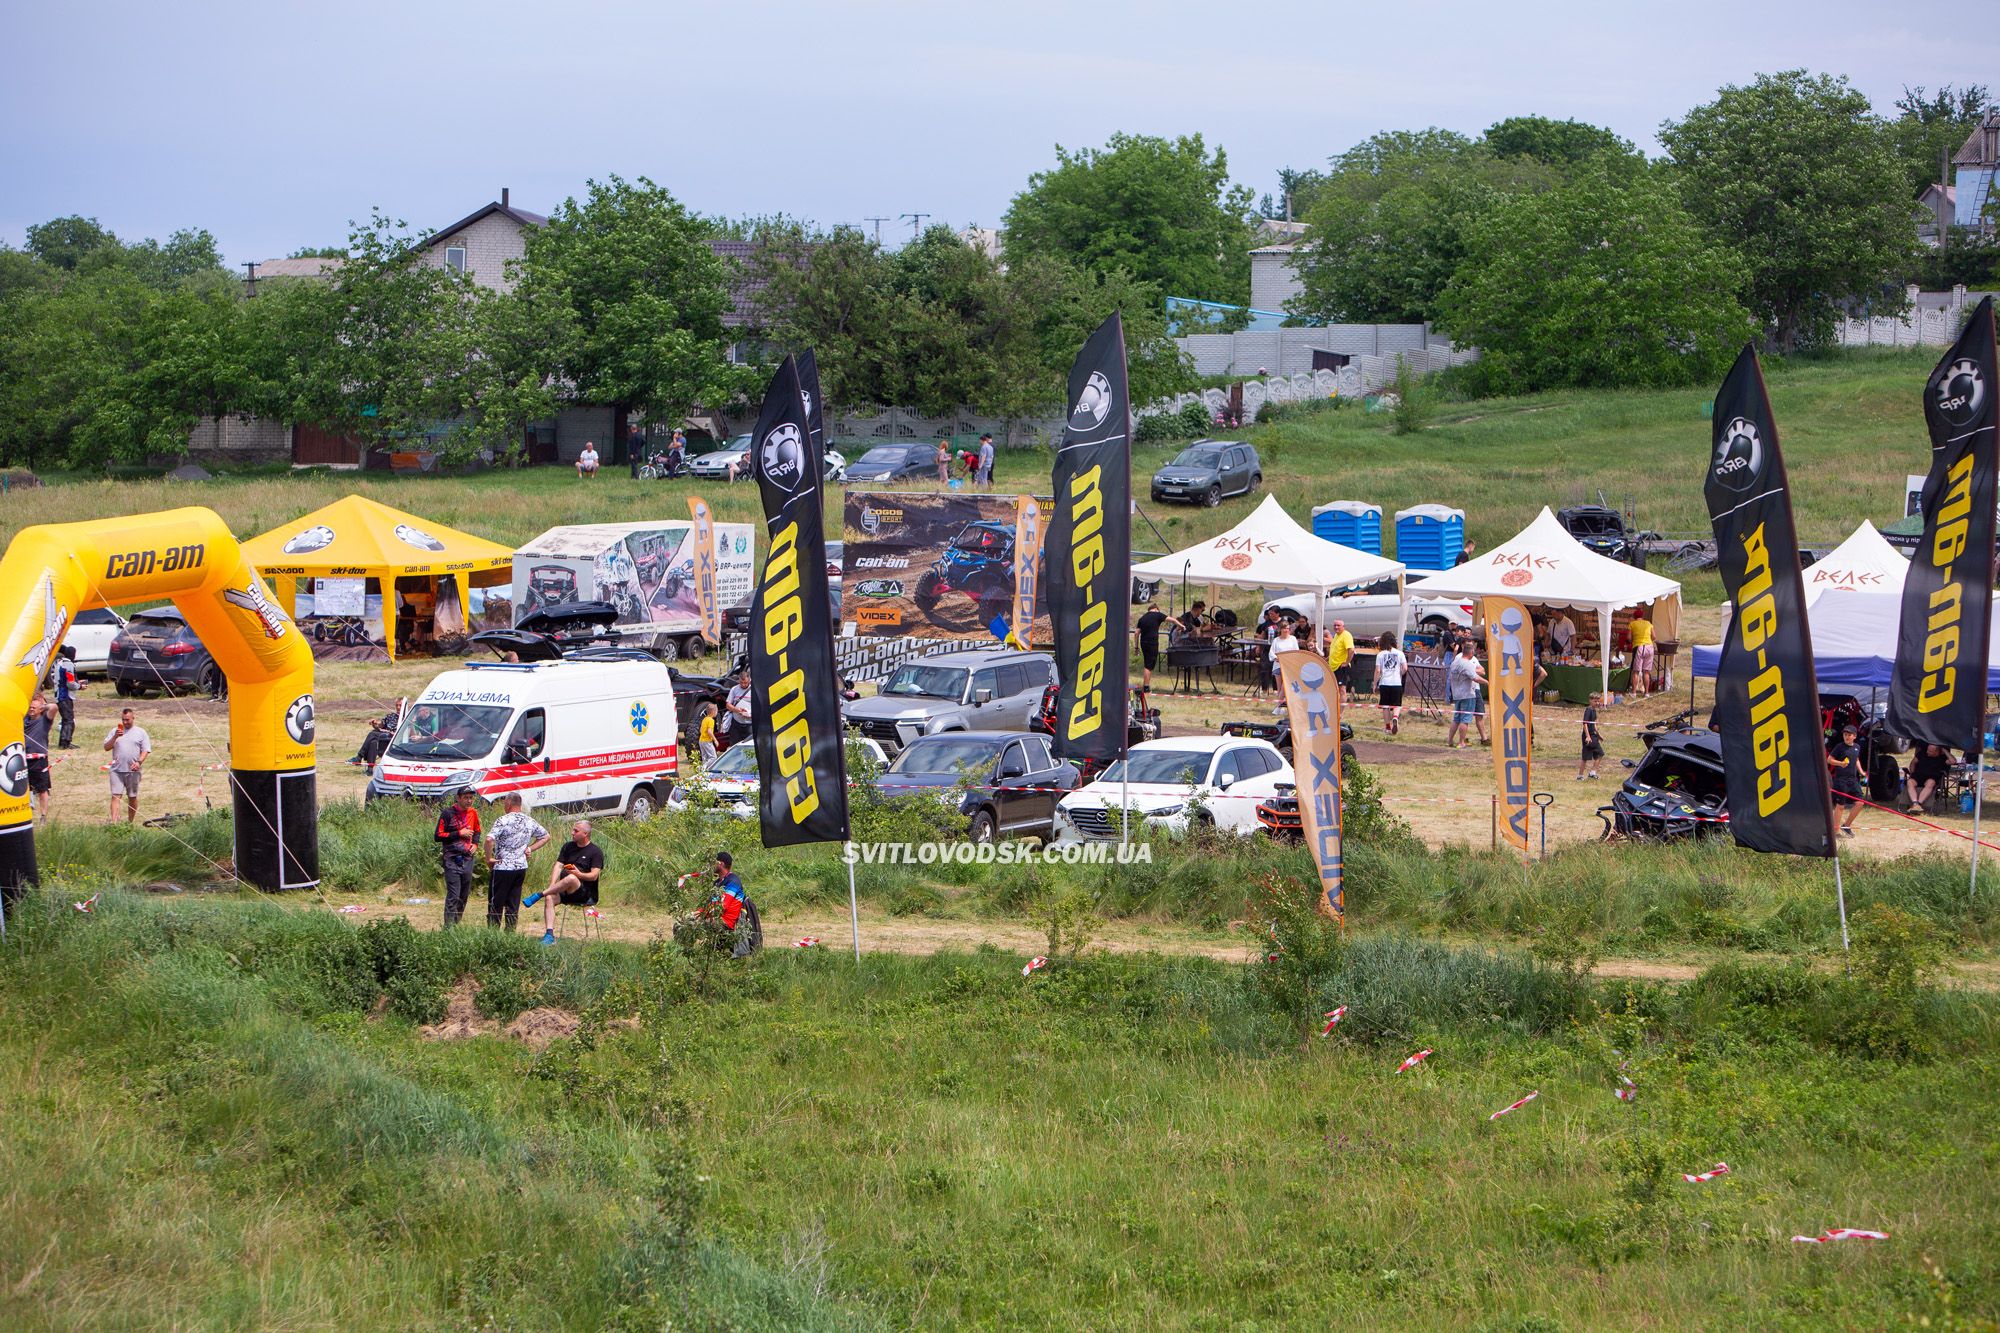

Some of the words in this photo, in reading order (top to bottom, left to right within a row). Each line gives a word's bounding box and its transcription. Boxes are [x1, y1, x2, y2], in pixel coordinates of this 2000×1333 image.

[105, 543, 205, 580] can-am
[855, 557, 909, 568] can-am
[246, 583, 286, 638] can-am
[860, 612, 895, 620] VIDEX
[578, 755, 608, 767] ЕКСТРЕНА
[608, 752, 635, 765] МЕДИЧНА
[635, 748, 666, 761] ДОПОМОГА
